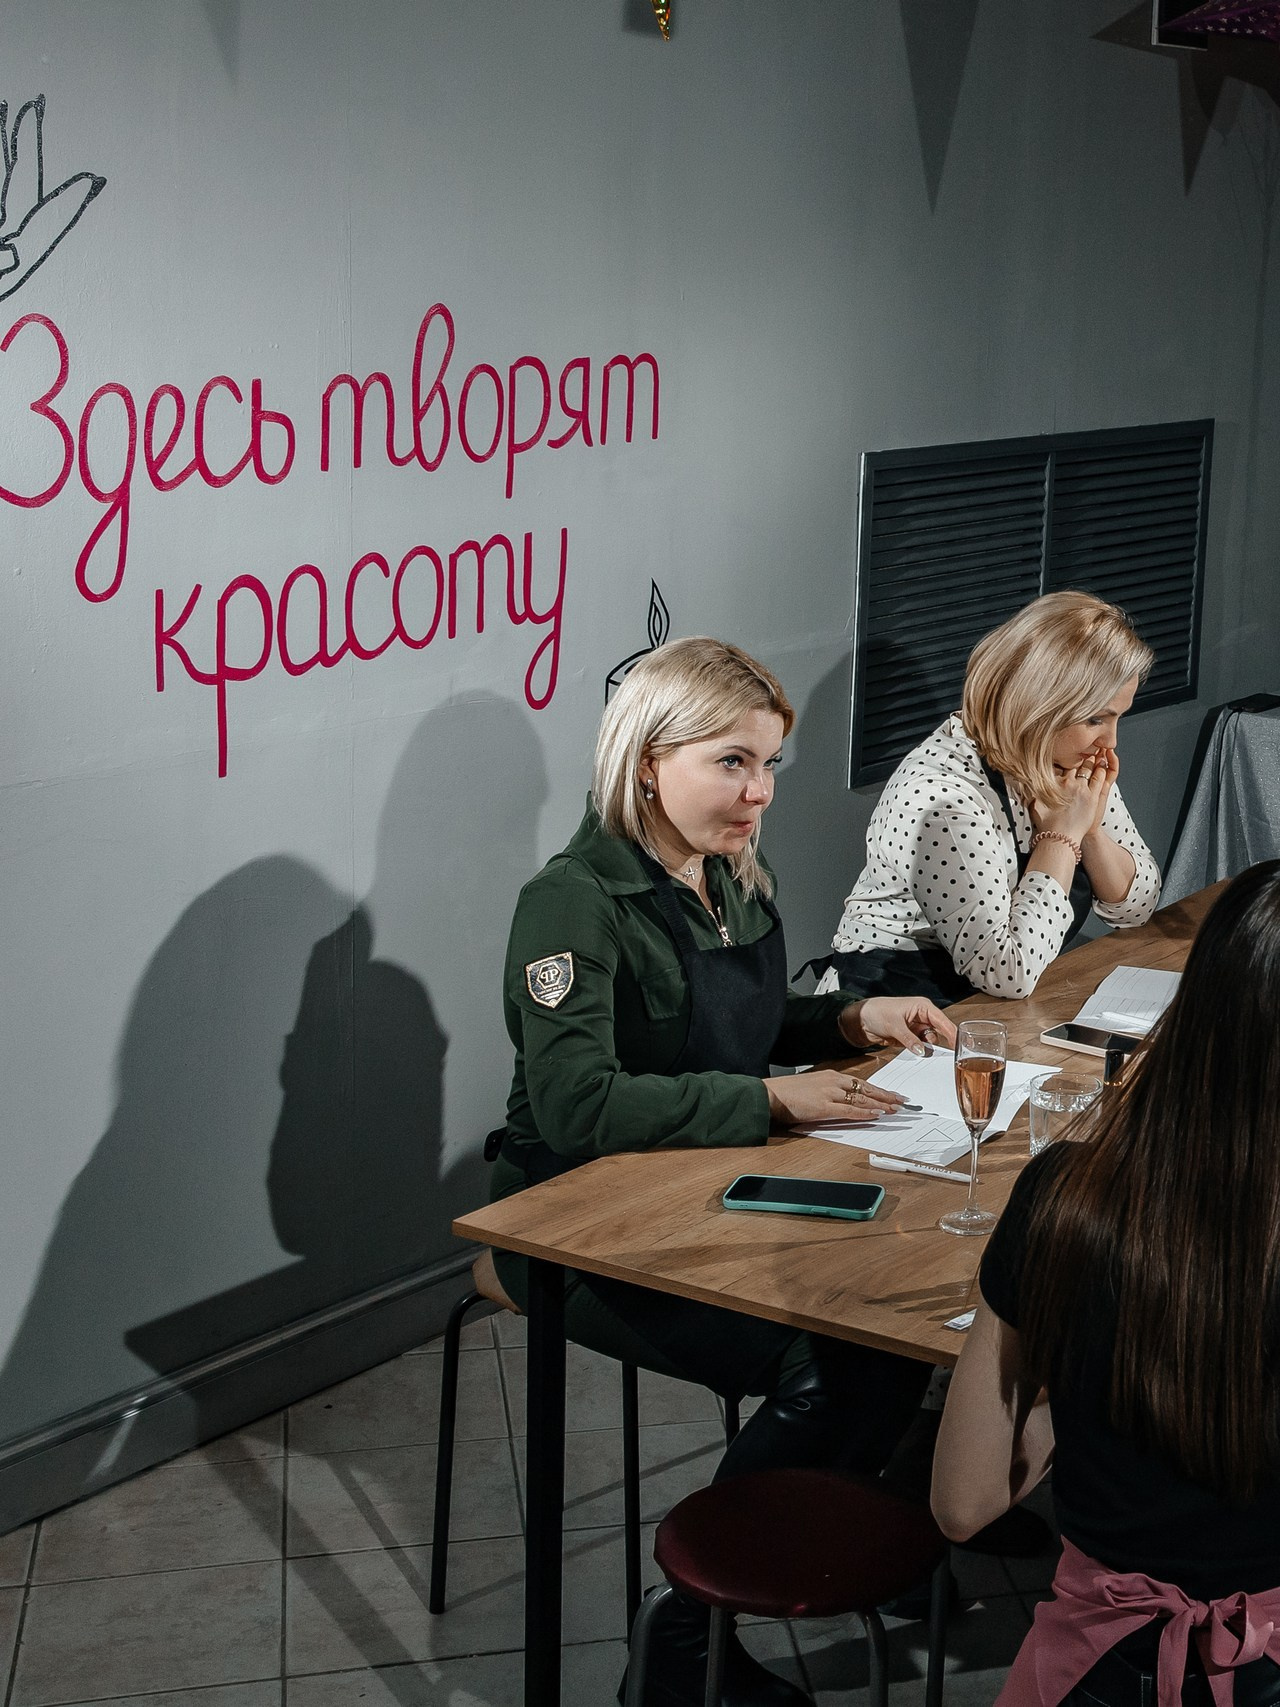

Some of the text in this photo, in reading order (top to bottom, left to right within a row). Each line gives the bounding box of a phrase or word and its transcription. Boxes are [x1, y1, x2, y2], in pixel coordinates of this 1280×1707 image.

[0, 303, 660, 603] Здесь творят
[155, 527, 569, 778] красоту
